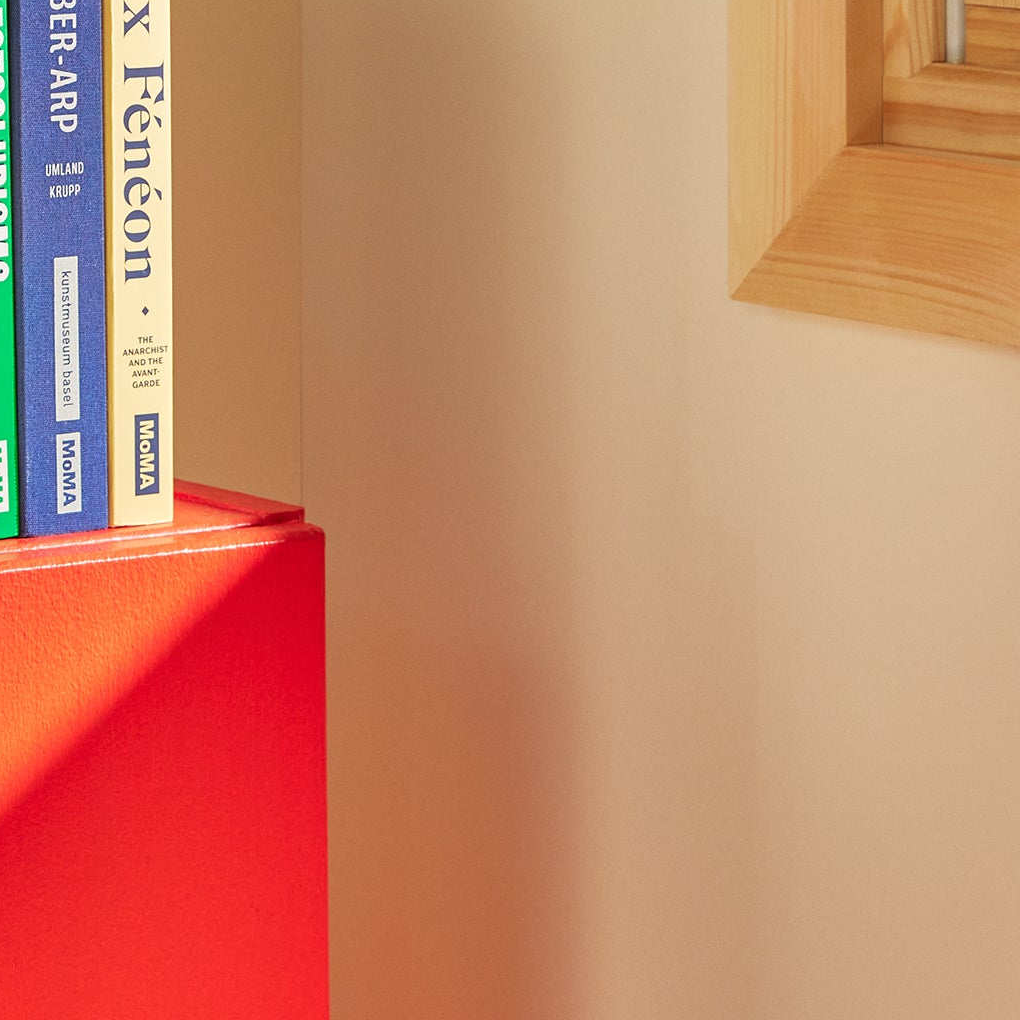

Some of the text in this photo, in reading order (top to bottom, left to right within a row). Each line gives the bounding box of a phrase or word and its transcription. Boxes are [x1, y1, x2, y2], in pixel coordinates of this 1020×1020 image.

[45, 161, 84, 177] UMLAND
[122, 62, 165, 284] Fénéon
[49, 183, 81, 198] KRUPP
[61, 270, 74, 408] kunstmuseum basel
[137, 335, 154, 344] THE
[122, 345, 168, 356] ANARCHIST
[128, 356, 163, 367] AND THE
[131, 368, 160, 377] AVANT-
[132, 379, 160, 388] GARDE
[139, 420, 155, 491] MoMA
[61, 438, 76, 507] MoMA
